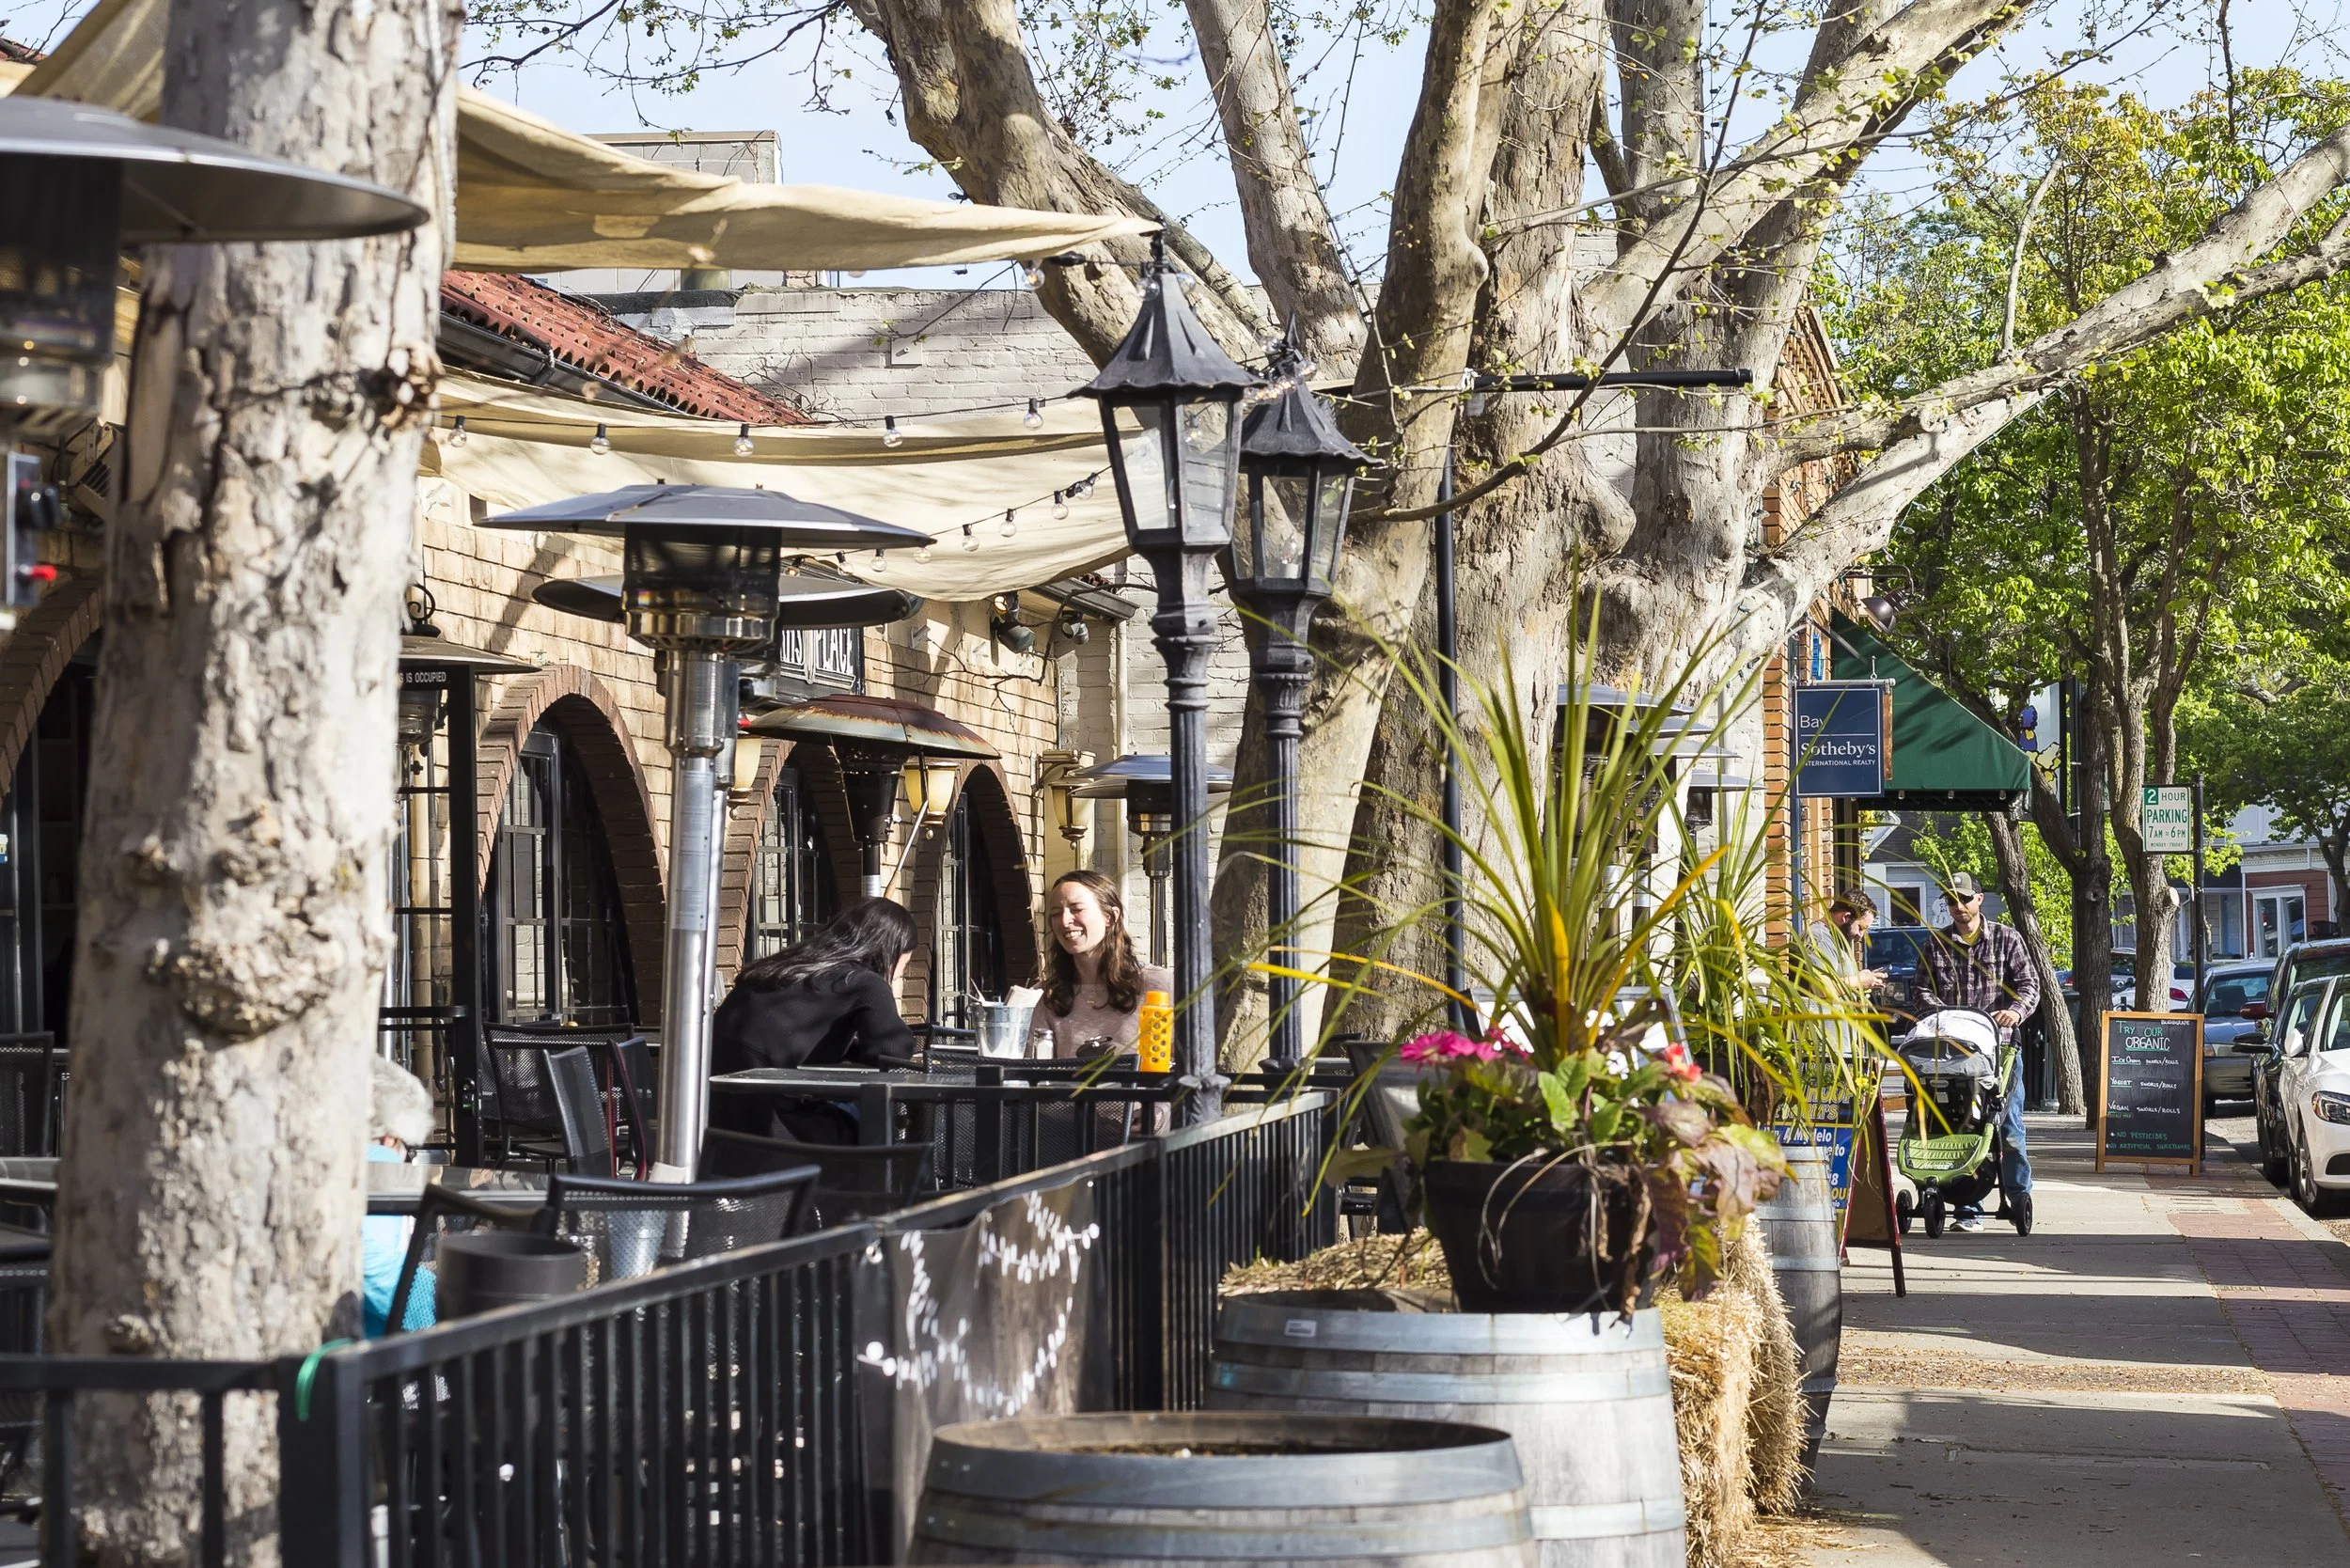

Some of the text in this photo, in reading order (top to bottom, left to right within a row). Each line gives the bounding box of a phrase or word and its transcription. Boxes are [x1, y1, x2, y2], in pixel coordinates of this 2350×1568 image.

[814, 627, 854, 675] PLACE
[405, 672, 413, 683] IS
[415, 671, 446, 682] OCCUPIED
[1801, 741, 1876, 758] Sotheby's
[2147, 789, 2186, 804] 2 HOUR
[2147, 809, 2187, 823] PARKING
[2144, 1027, 2163, 1037] OUR
[2125, 1036, 2170, 1050] ORGANIC
[2108, 1100, 2129, 1111] VEGAN
[2130, 1132, 2168, 1140] PESTICIDES
